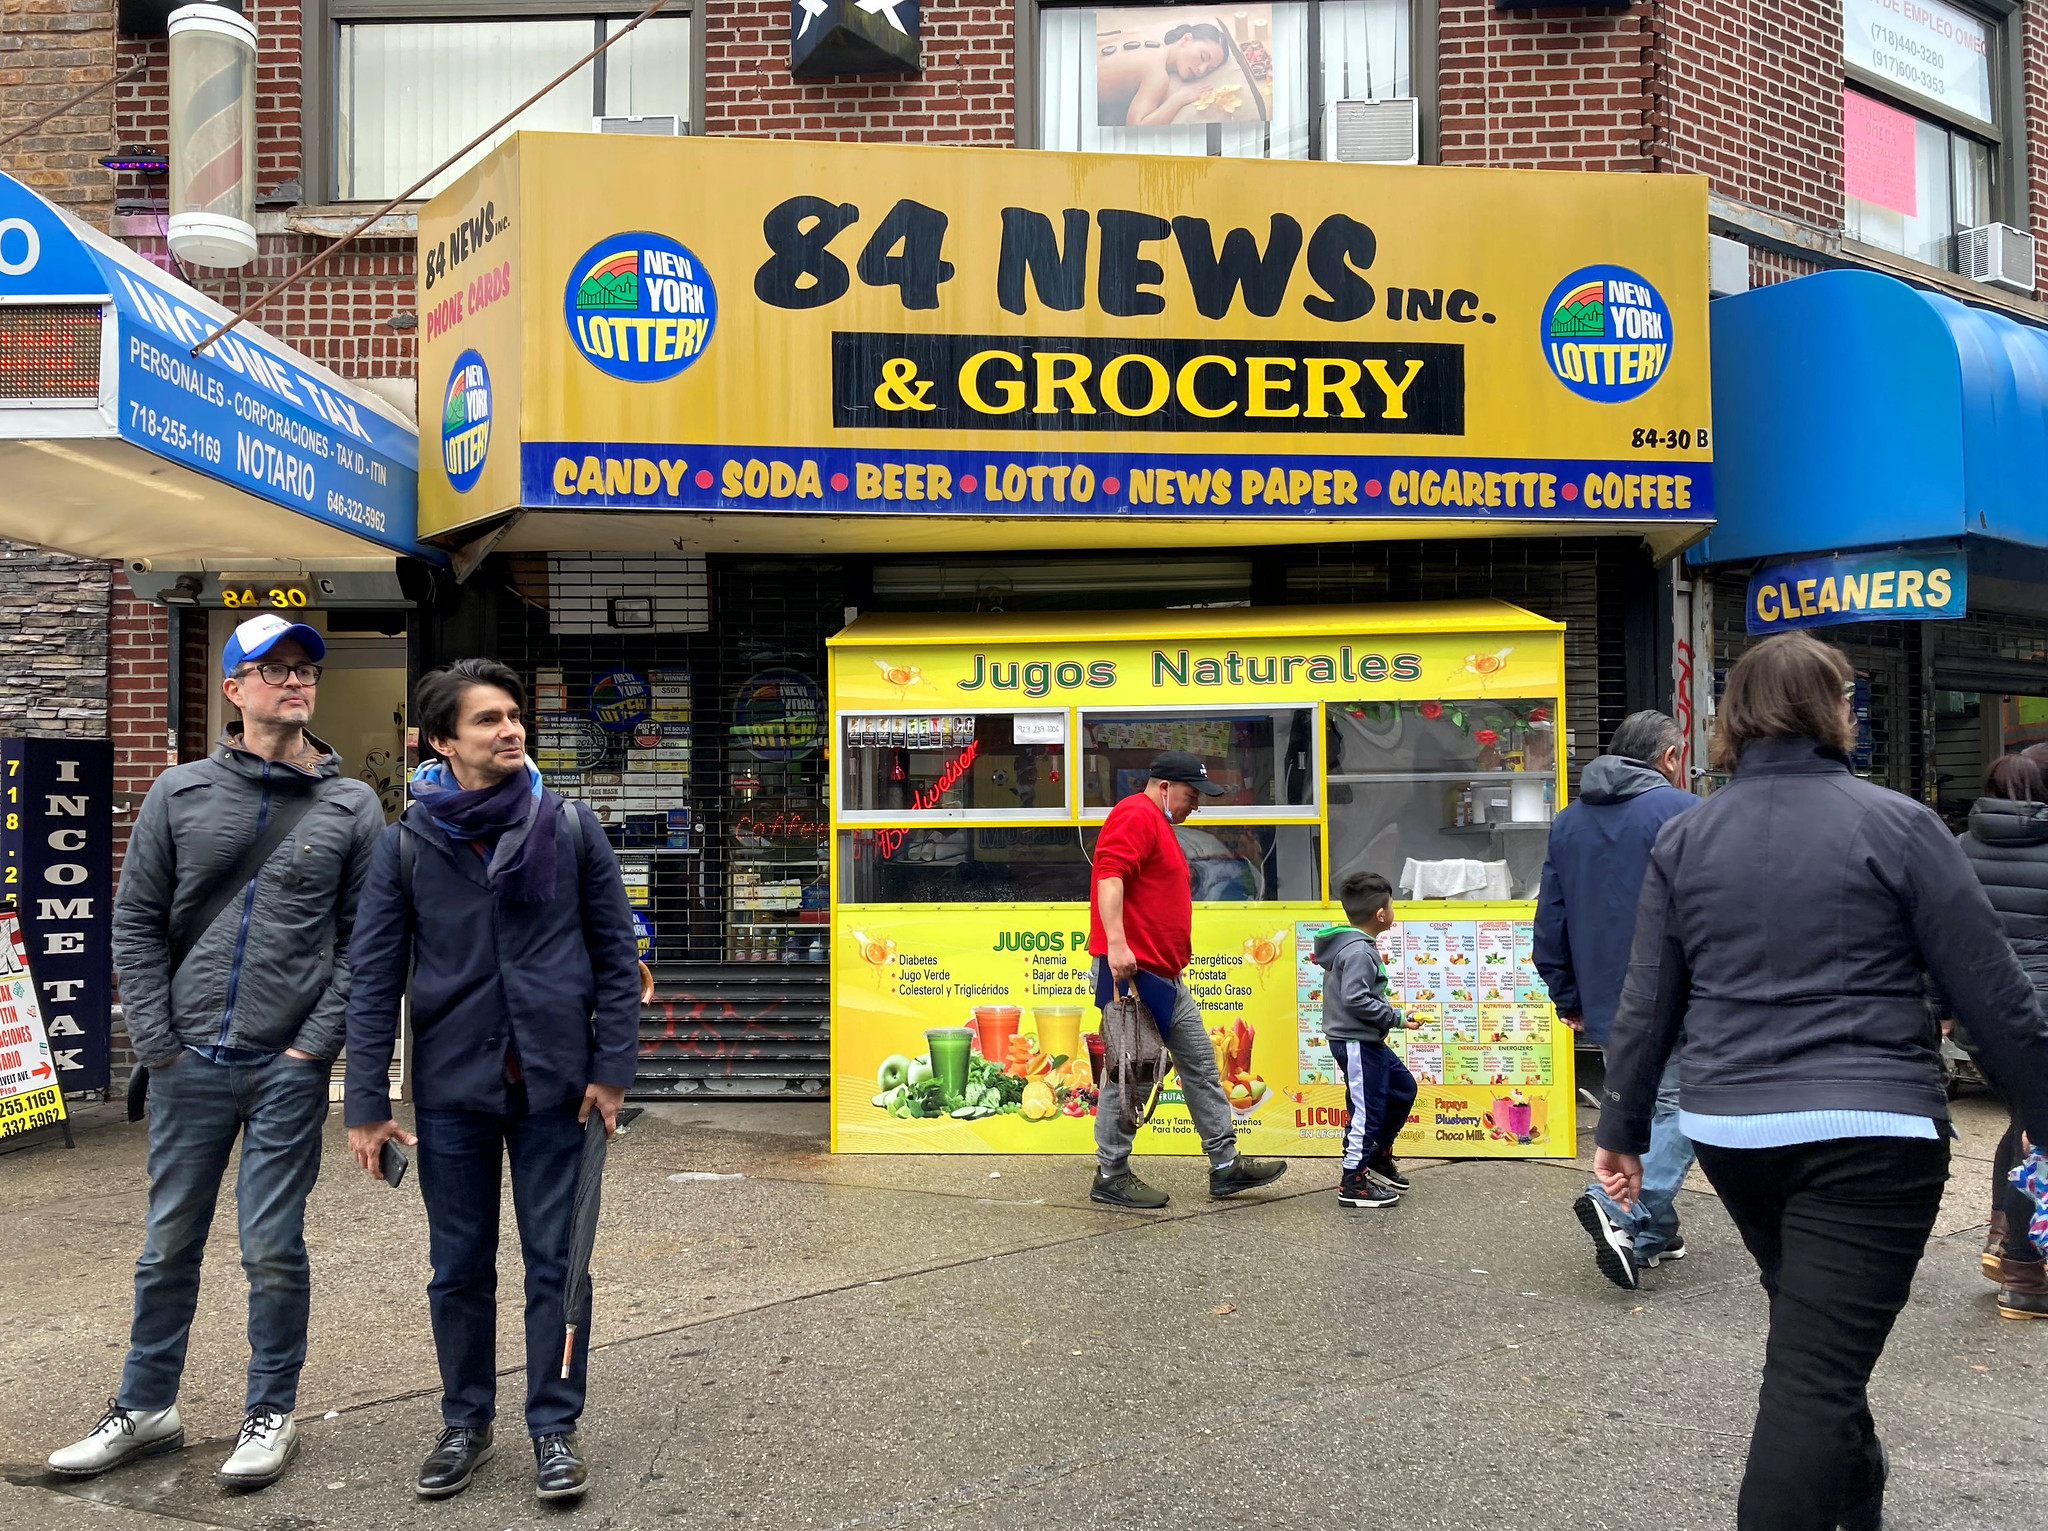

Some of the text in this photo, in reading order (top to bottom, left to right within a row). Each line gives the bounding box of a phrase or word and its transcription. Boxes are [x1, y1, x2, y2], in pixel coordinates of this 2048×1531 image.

[1904, 1, 1953, 39] EMPLEO
[1871, 22, 1944, 69] (718)440-3280
[1873, 48, 1945, 95] (917)600-3353
[426, 201, 510, 290] 84 NEWS INC.
[643, 250, 692, 280] NEW
[754, 195, 1496, 324] 84 NEWS INC.
[426, 261, 510, 343] PHONE CARDS
[645, 277, 705, 314] YORK
[1608, 280, 1652, 308] NEW
[1610, 306, 1663, 339] YORK
[577, 316, 709, 362] LOTTERY
[116, 269, 304, 406] INCOME
[296, 374, 373, 443] TAX
[1551, 342, 1667, 385] LOTTERY
[465, 365, 484, 388] NEW
[874, 350, 1424, 418] & GROCERY
[130, 336, 224, 408] PERSONALES
[235, 392, 328, 458] CORPORACIONES
[336, 442, 353, 471] TAX
[354, 452, 364, 475] ID
[371, 460, 387, 487] ITIN
[466, 389, 488, 423] YORK
[130, 401, 221, 464] 718-255-1169
[1631, 427, 1709, 450] 84-30 B
[445, 420, 490, 475] LOTTERY
[237, 432, 315, 501] NOTARIO
[553, 456, 1692, 510] CANDY SODA BEER LOTTO NEWS PAPER CIGARETTE COFFEE
[327, 490, 385, 532] 646-322-5962
[320, 579, 334, 594] C
[1757, 567, 1952, 622] CLEANERS
[957, 645, 1422, 699] Jugos Naturales
[594, 775, 612, 783] STOP
[603, 788, 619, 796] MASK
[993, 932, 1065, 952] JUGOS
[899, 954, 937, 966] Diabetes
[1032, 954, 1067, 965] Anemia
[1189, 954, 1243, 967] Energéticos
[899, 969, 950, 983] Jugo Verde
[1032, 969, 1089, 982] Bajar de Pes
[1189, 969, 1226, 980] Próstata
[899, 983, 1009, 997] Colesterol y Triglicéridos
[1032, 984, 1072, 997] Limpieza
[1076, 984, 1086, 995] de
[1189, 984, 1252, 997] Hígado Graso
[1193, 999, 1243, 1010] efrescante
[0, 1025, 32, 1048] ACIONES
[0, 1050, 22, 1071] ARIO
[17, 1071, 31, 1081] AVE.
[1434, 1097, 1468, 1112] Papaya
[1233, 1117, 1262, 1127] queños
[1435, 1113, 1481, 1127] Blueberry
[1299, 1129, 1346, 1139] EN LECH
[1397, 1131, 1425, 1142] ango
[1436, 1130, 1486, 1141] Choco Milk
